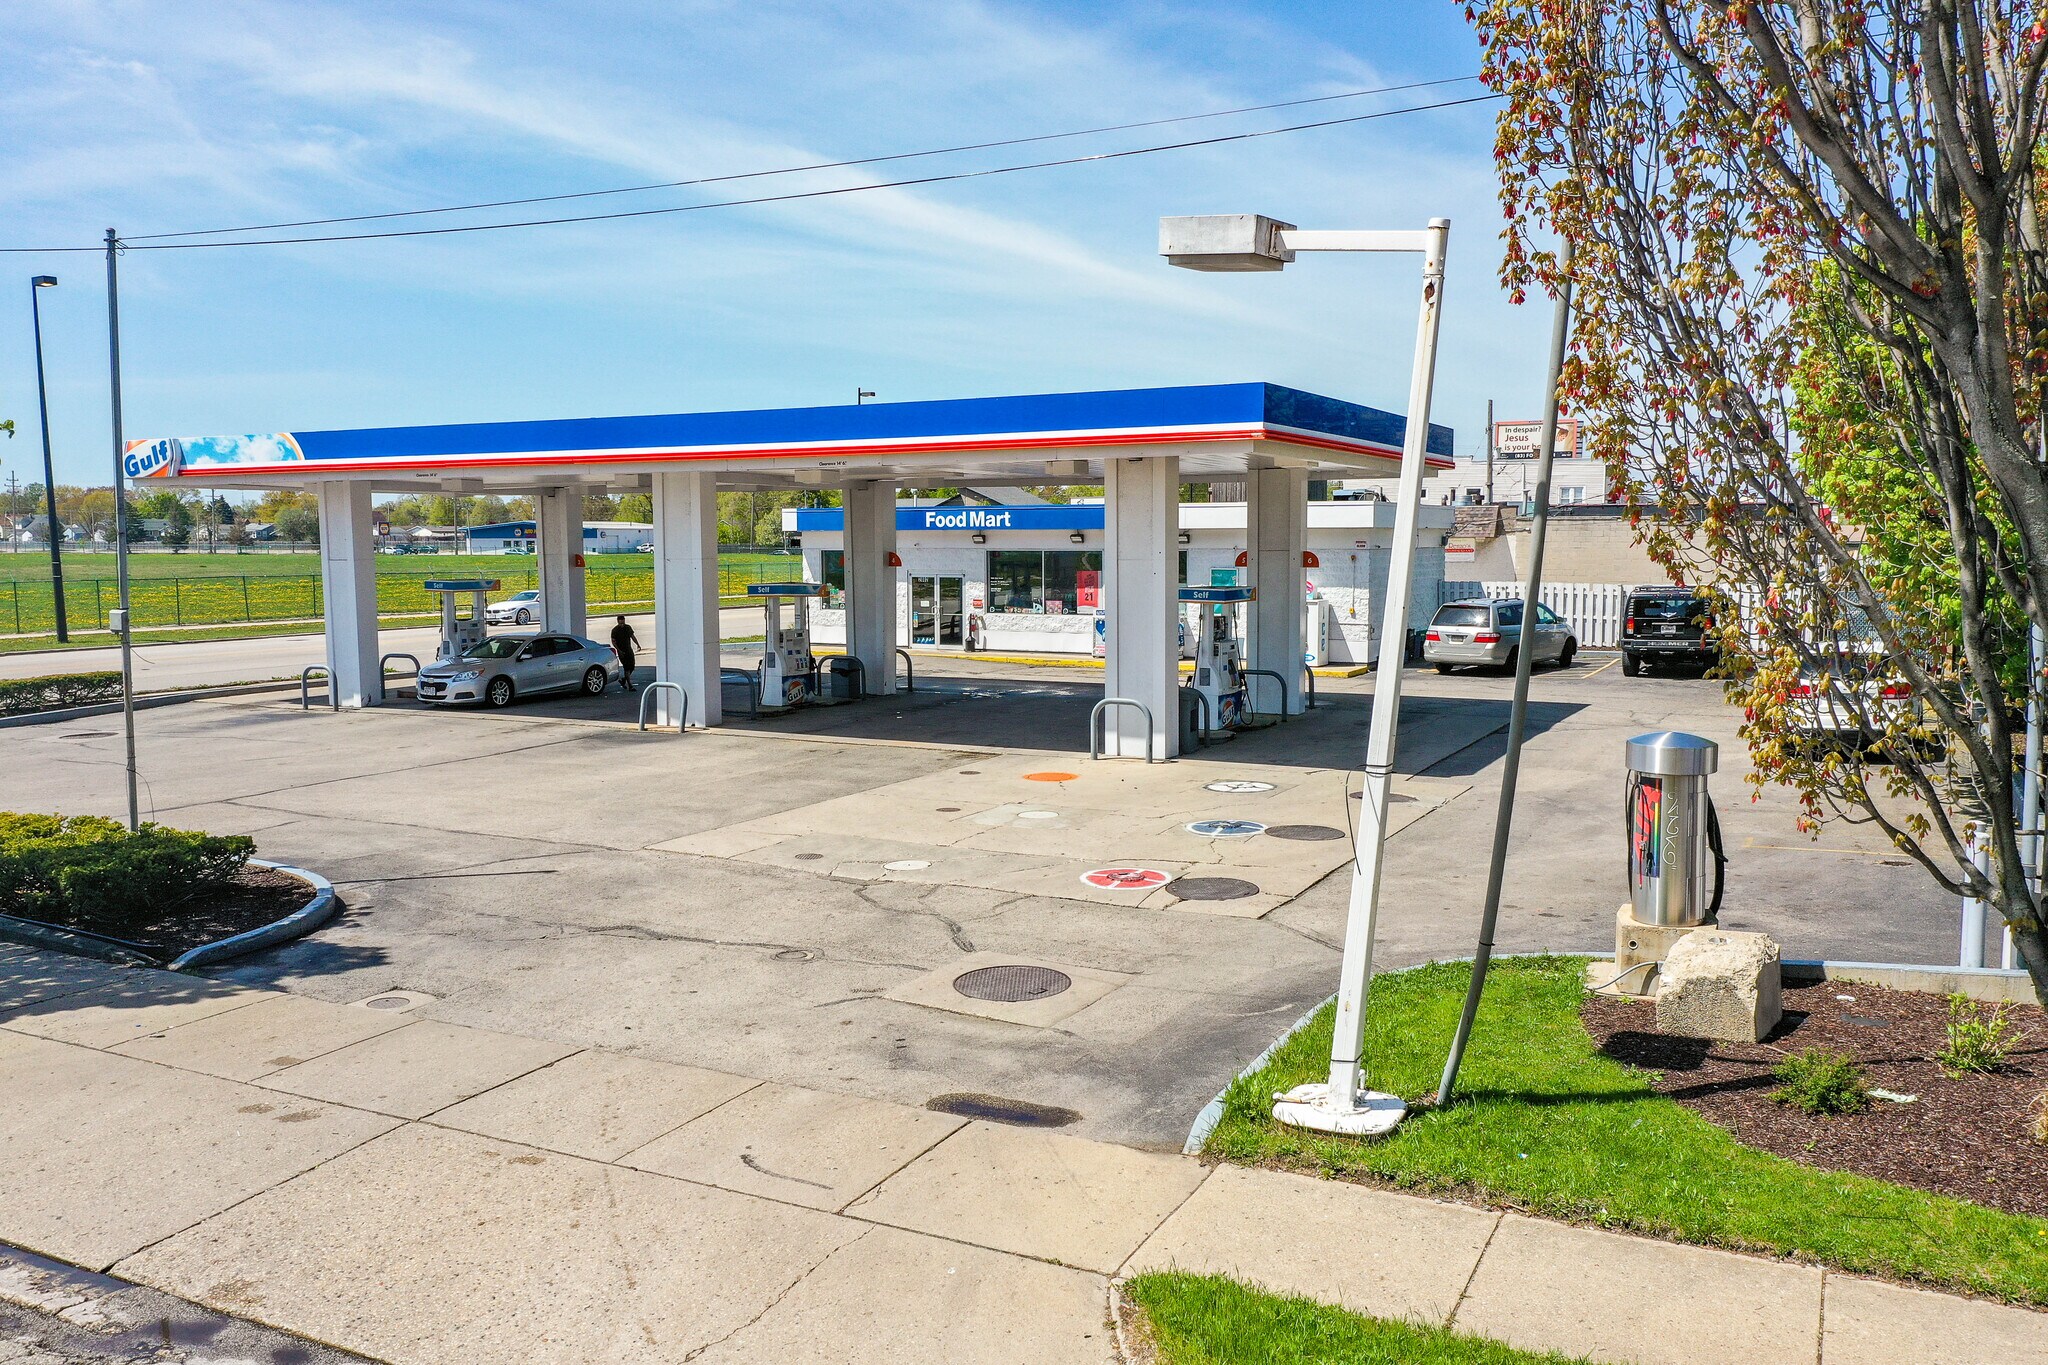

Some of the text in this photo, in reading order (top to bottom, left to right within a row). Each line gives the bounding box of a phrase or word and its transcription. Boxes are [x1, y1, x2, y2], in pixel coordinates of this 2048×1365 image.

[1513, 426, 1542, 434] despair?
[1505, 434, 1529, 442] Jesus
[1512, 444, 1532, 452] your
[124, 440, 168, 477] Gulf
[925, 511, 1011, 528] Food Mart
[1084, 592, 1093, 601] 21
[1193, 591, 1209, 599] Self
[787, 686, 804, 702] Gulf
